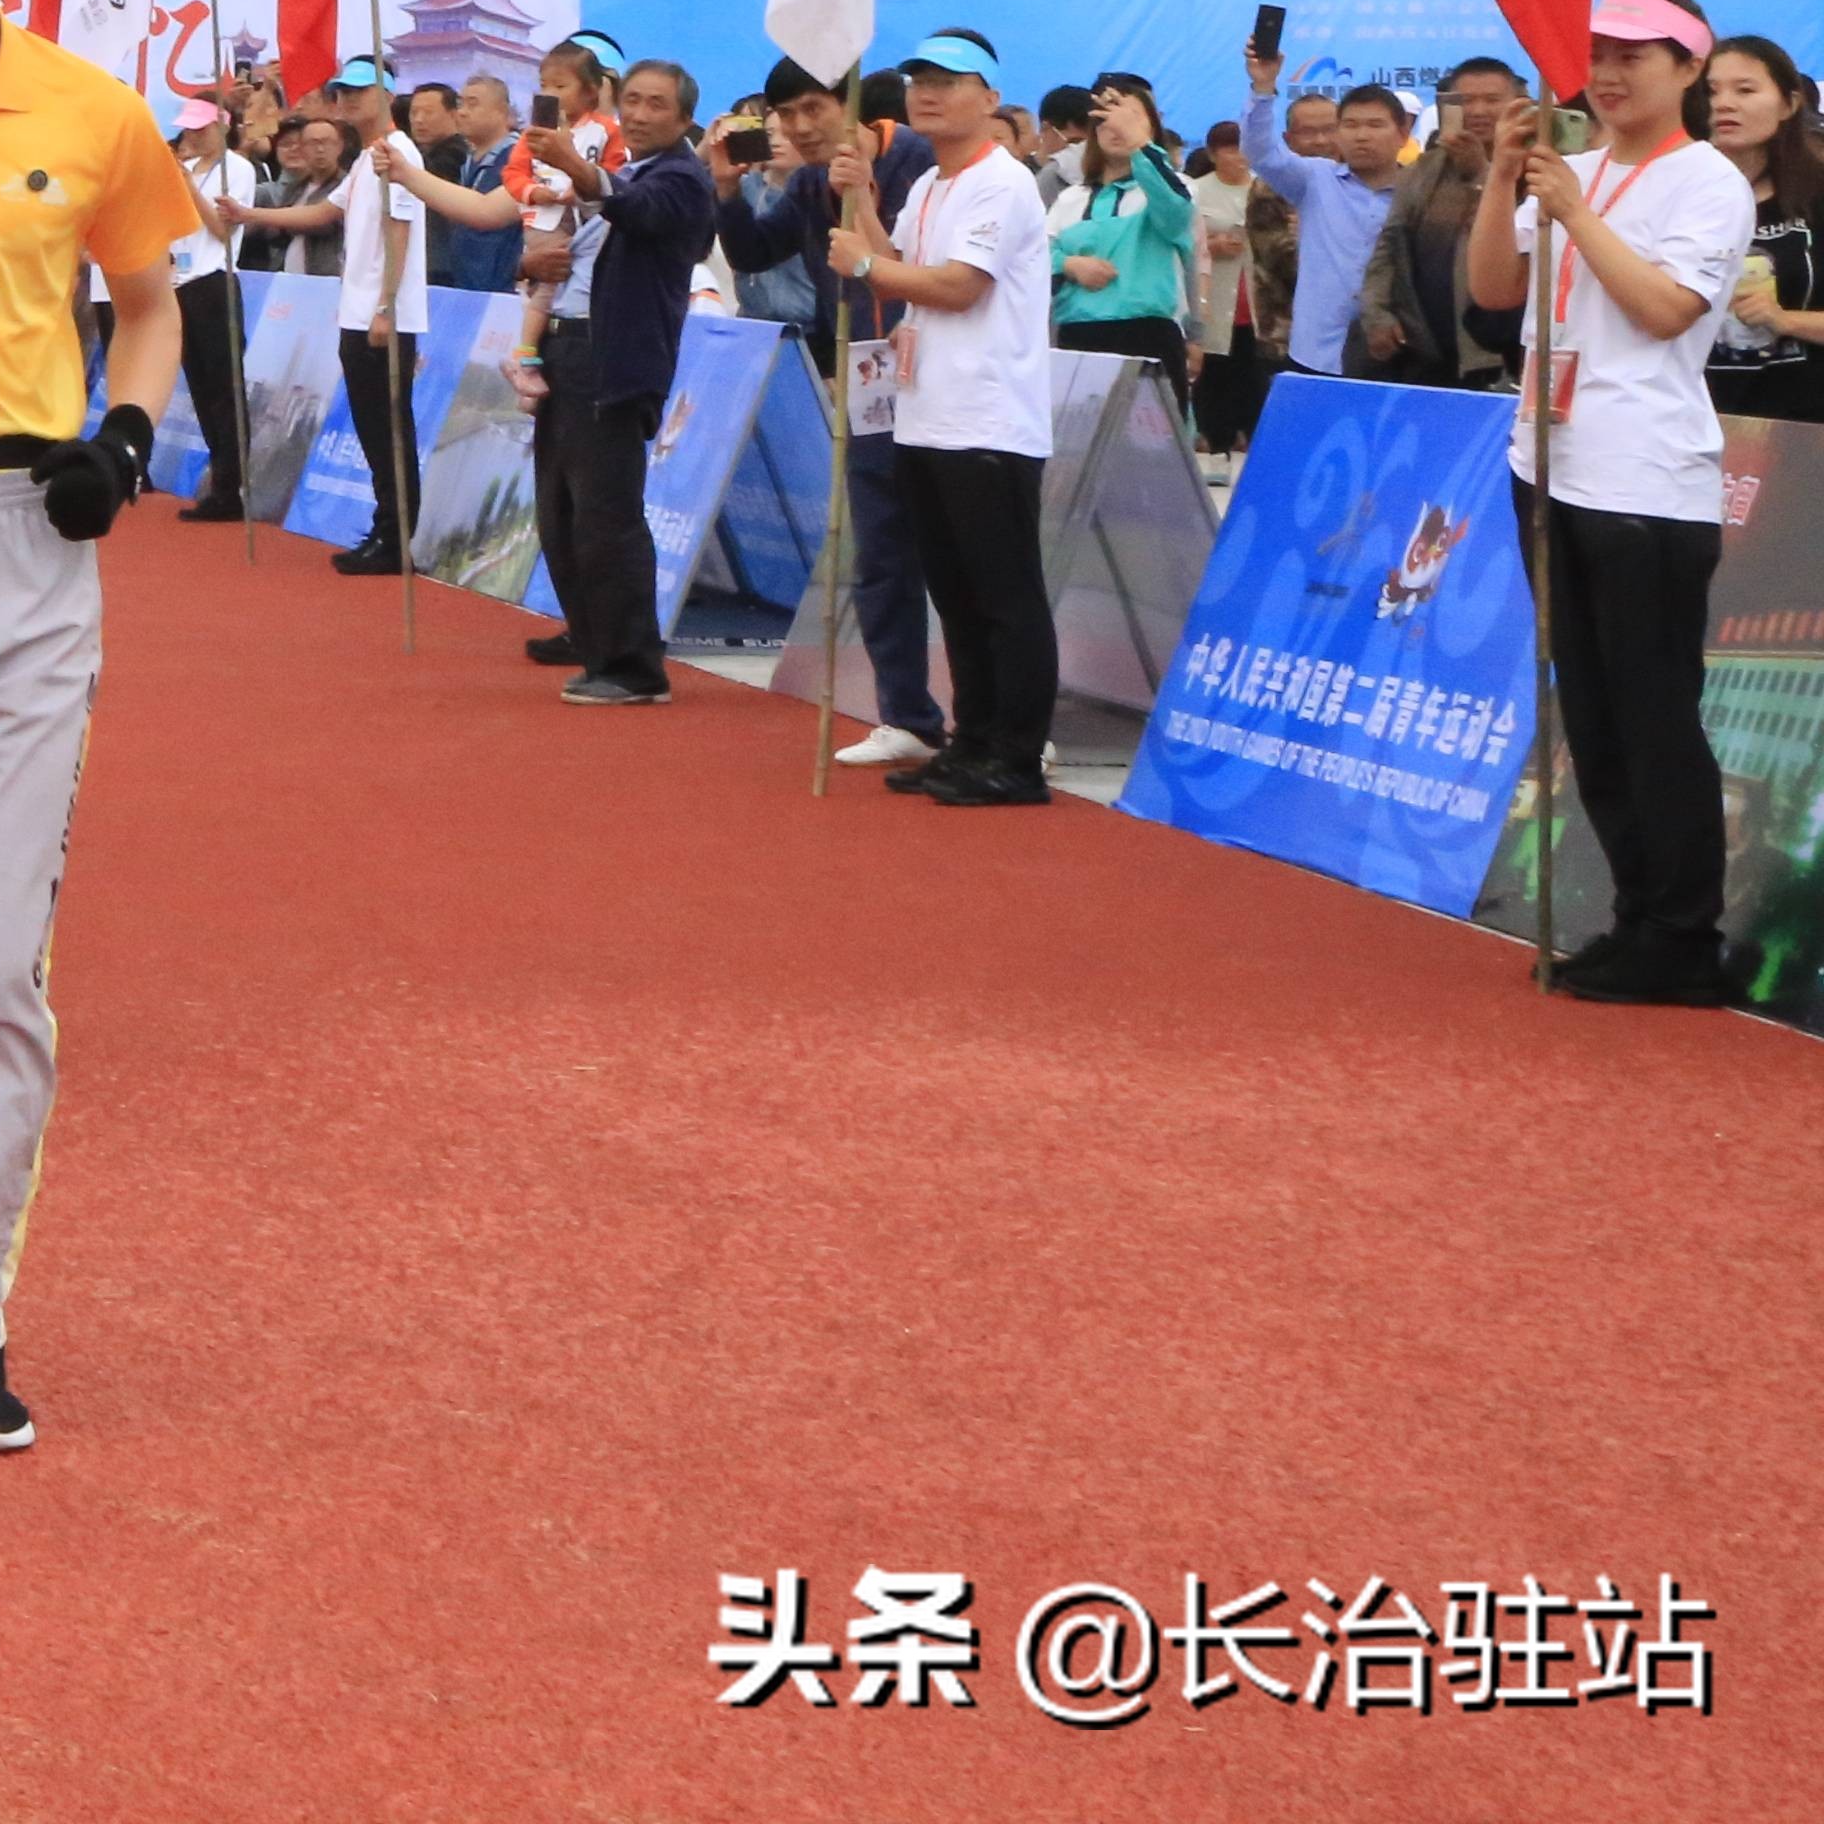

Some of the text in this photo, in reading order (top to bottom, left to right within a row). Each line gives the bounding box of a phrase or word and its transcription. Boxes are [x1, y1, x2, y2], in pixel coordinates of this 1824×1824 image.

[1184, 632, 1517, 767] 中华人民共和国第二届青年运动会
